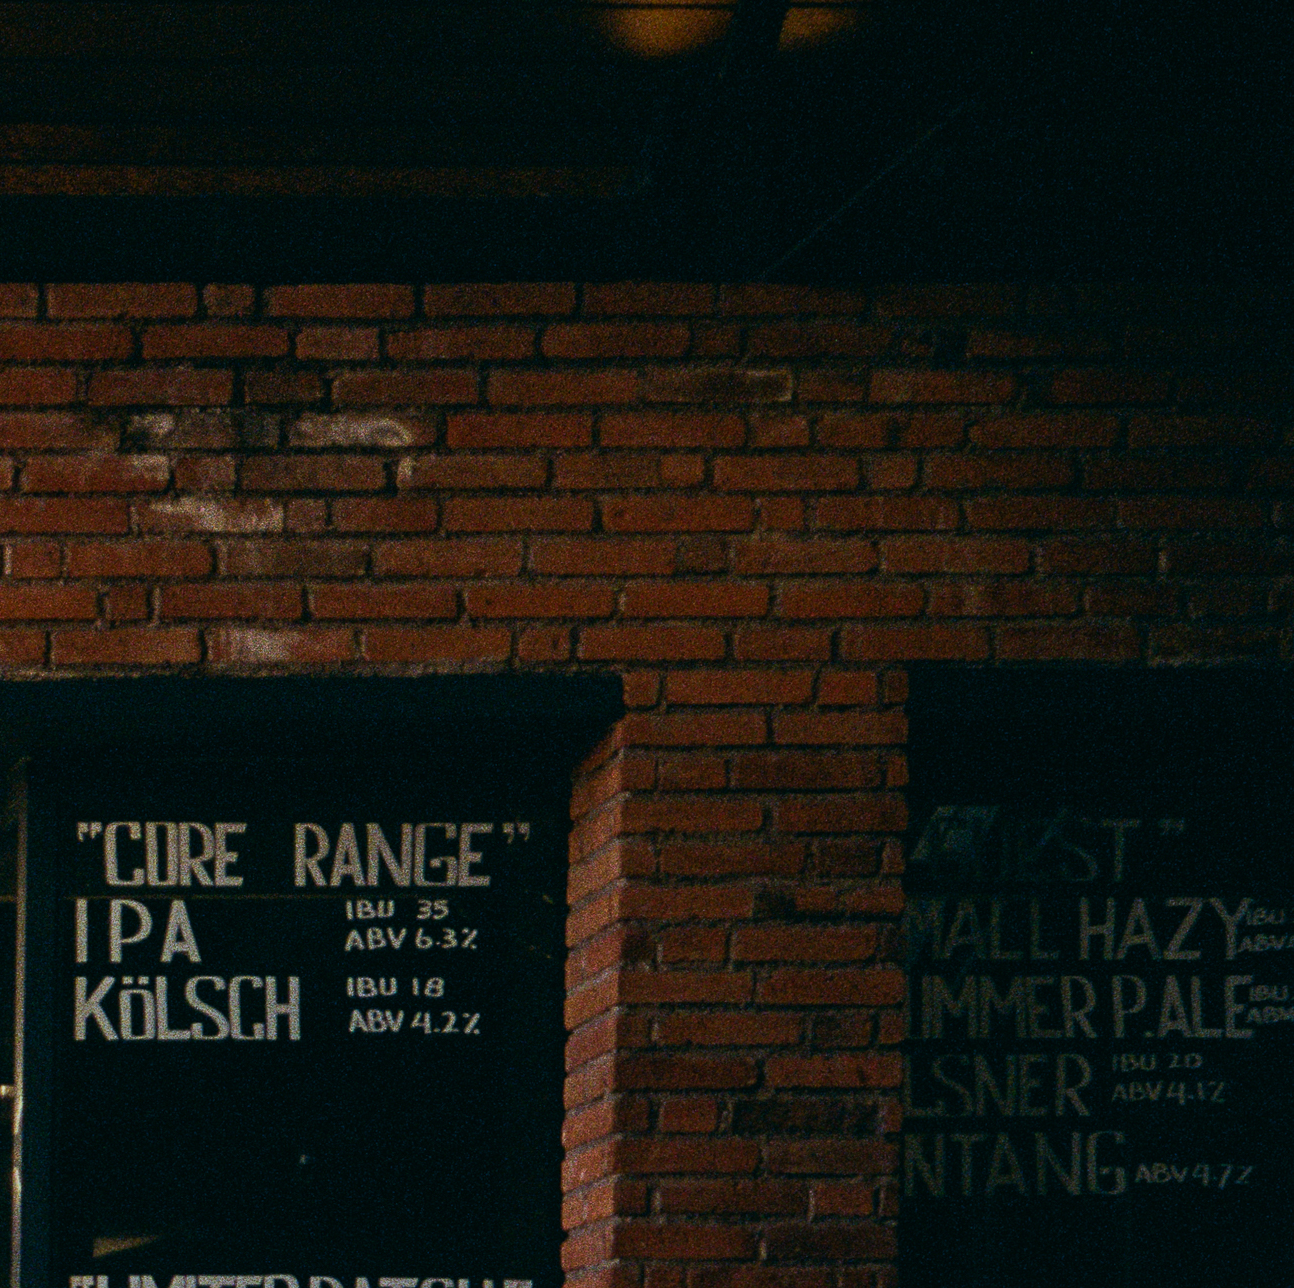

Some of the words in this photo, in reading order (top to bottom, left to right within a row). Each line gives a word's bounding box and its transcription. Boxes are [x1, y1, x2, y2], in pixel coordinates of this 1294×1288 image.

[345, 899, 395, 921] IBU
[416, 899, 450, 920] 35
[1246, 907, 1287, 926] IBU
[74, 899, 202, 964] IPA
[344, 926, 407, 952] ABV
[414, 927, 479, 951] 6.3%
[1078, 897, 1252, 960] HAZY
[346, 977, 398, 998] IBU
[411, 977, 446, 998] 18
[348, 1008, 405, 1033] ABV
[410, 1010, 481, 1035] 4.2%
[1112, 1052, 1157, 1072] IBU
[1168, 1052, 1204, 1069] 20
[1111, 1081, 1163, 1102] ABV
[1134, 1162, 1188, 1184] ABV
